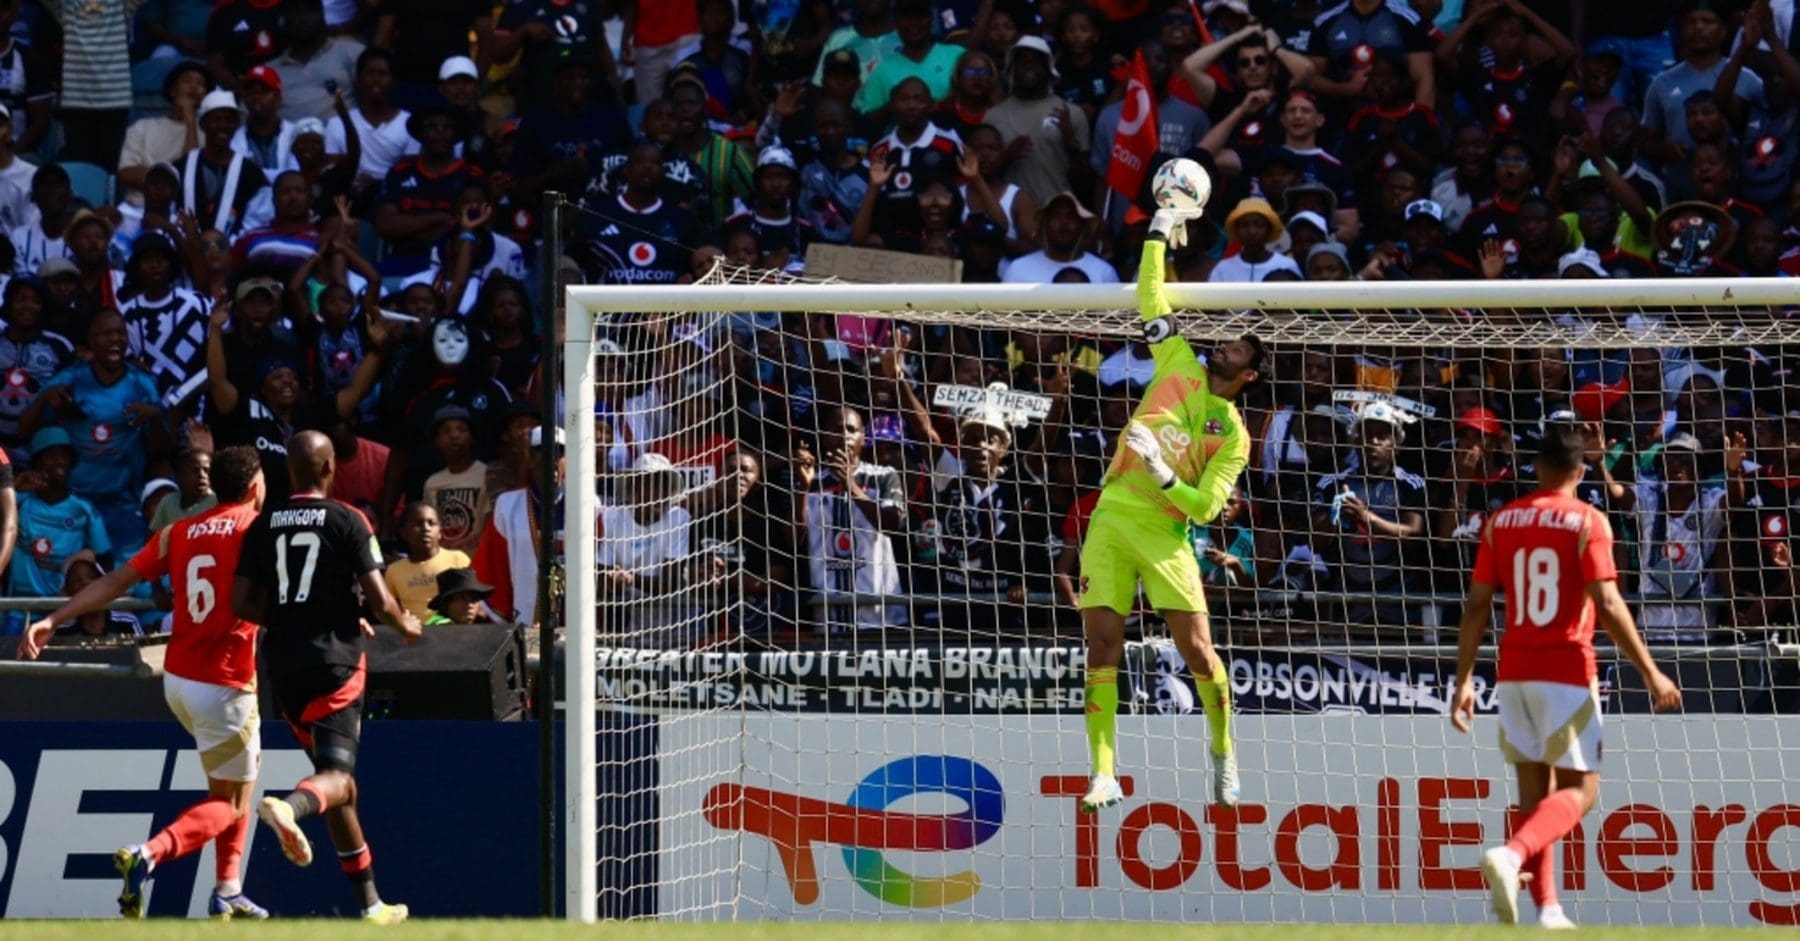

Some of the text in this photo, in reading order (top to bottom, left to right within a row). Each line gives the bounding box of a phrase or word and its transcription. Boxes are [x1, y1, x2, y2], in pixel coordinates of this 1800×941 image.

[269, 508, 328, 529] MAKGOPA
[186, 554, 218, 624] 6
[275, 531, 322, 605] 17
[1512, 546, 1561, 628] 18
[596, 675, 808, 706] MOLETSANE
[839, 685, 942, 708] TLADI
[759, 649, 934, 678] MOTLANA
[0, 748, 316, 919] ET
